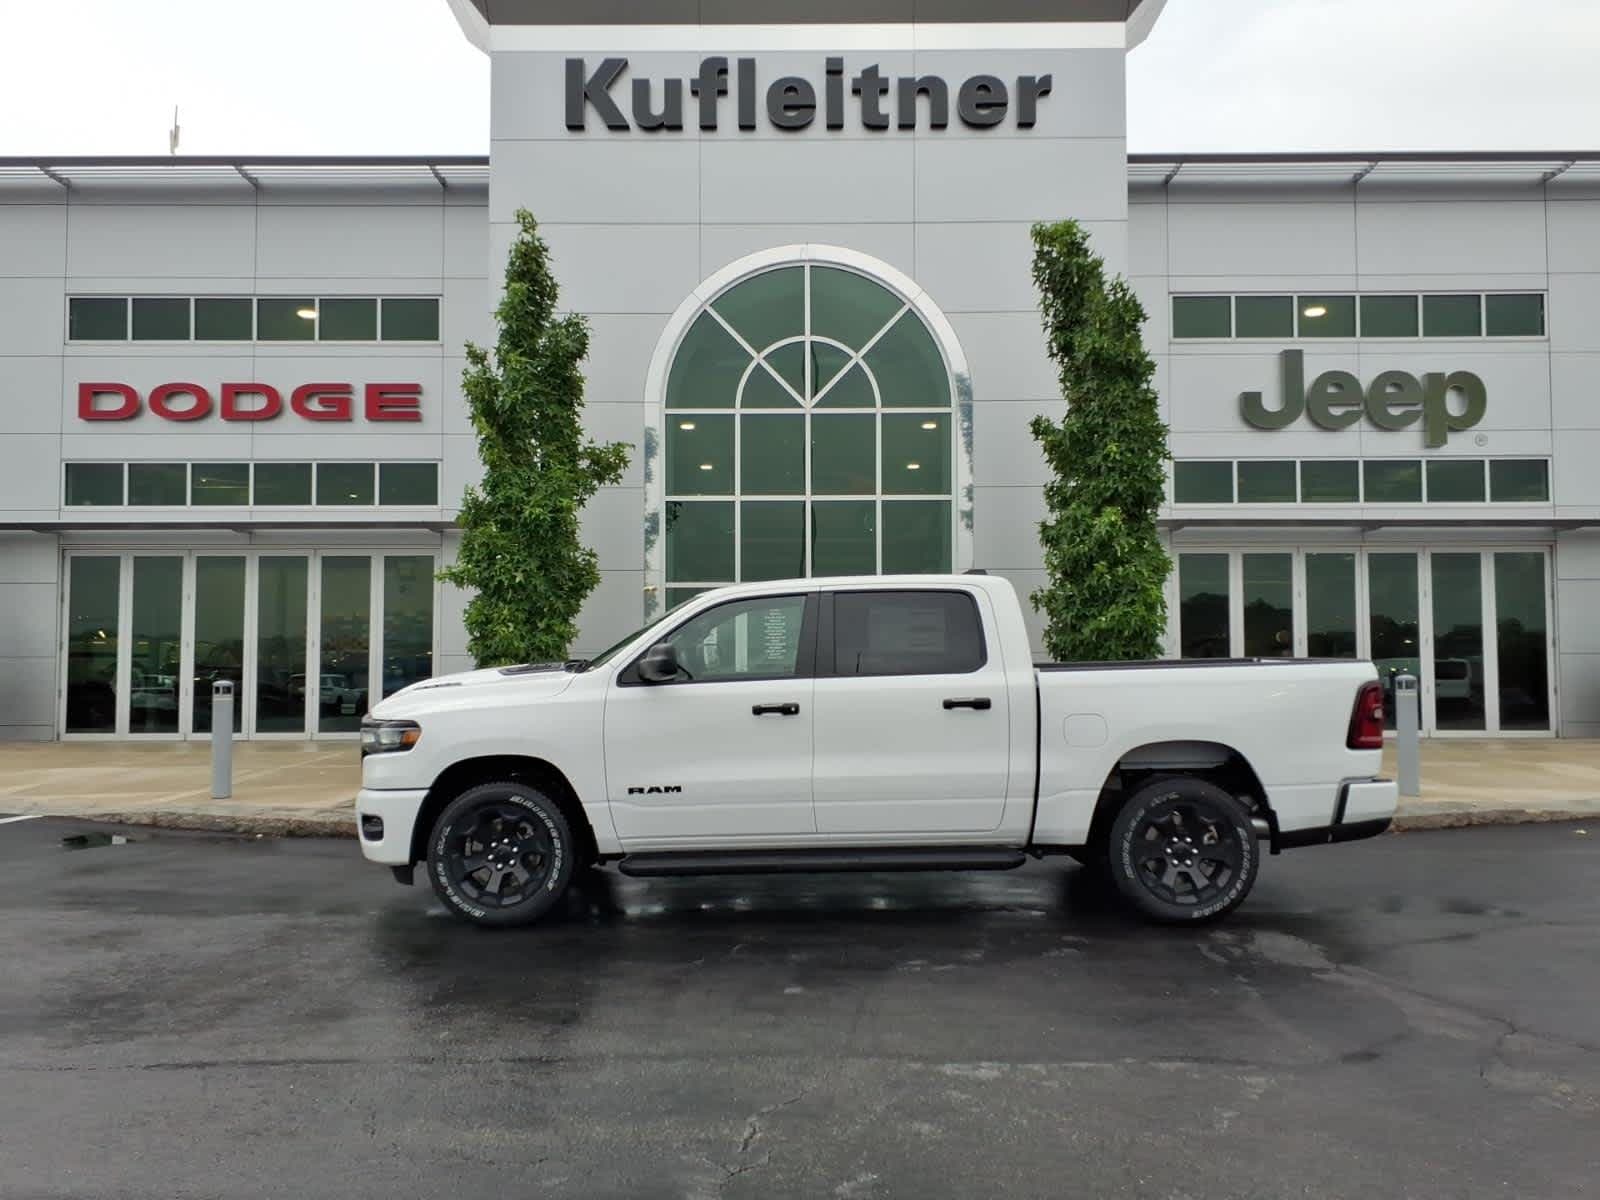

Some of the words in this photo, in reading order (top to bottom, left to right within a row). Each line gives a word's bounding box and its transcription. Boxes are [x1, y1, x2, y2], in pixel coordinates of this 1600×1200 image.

[565, 56, 1053, 132] Kufleitner
[78, 382, 422, 422] DODGE
[1238, 348, 1488, 449] Jeep
[628, 785, 682, 795] RAM
